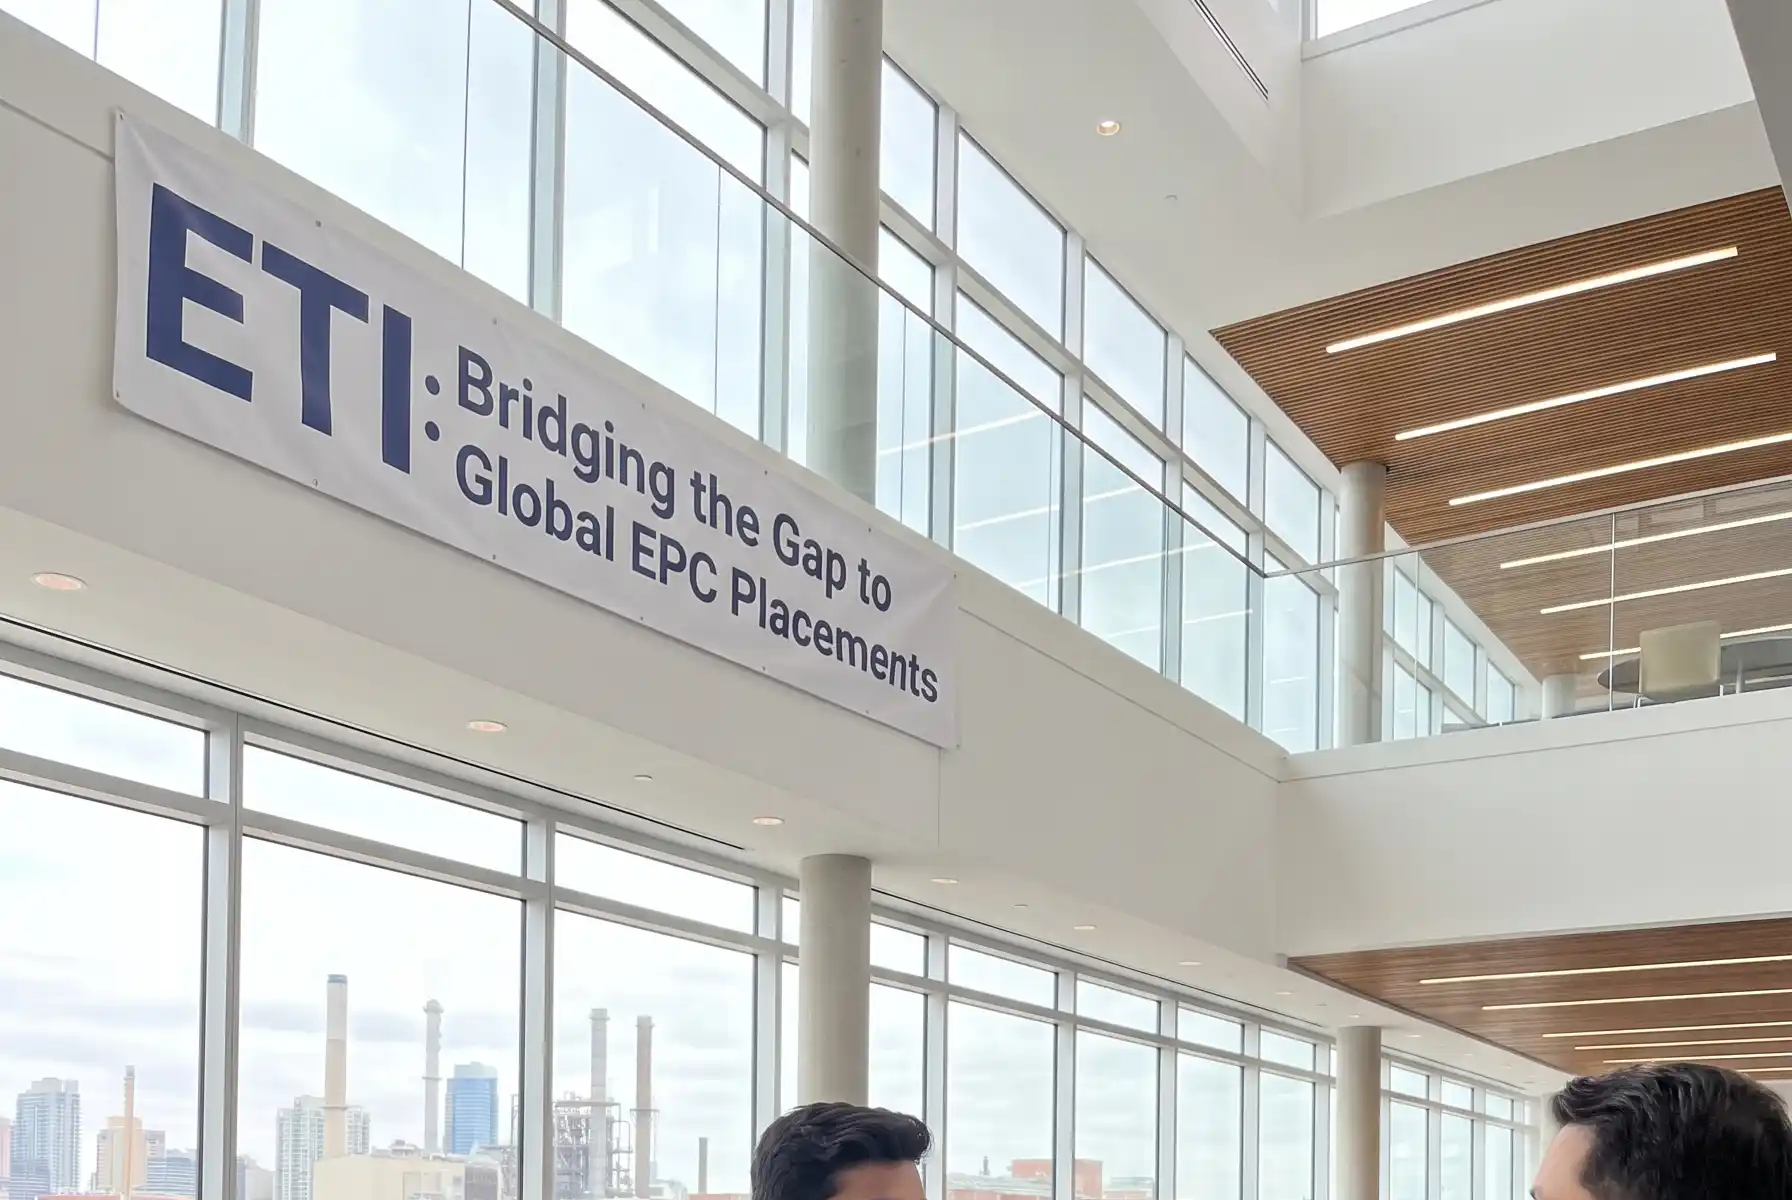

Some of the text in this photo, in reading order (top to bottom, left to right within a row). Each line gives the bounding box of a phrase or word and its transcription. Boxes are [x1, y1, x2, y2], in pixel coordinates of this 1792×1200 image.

[455, 444, 938, 703] Global EPC Placements
[458, 344, 892, 613] Bridging the Gap to
